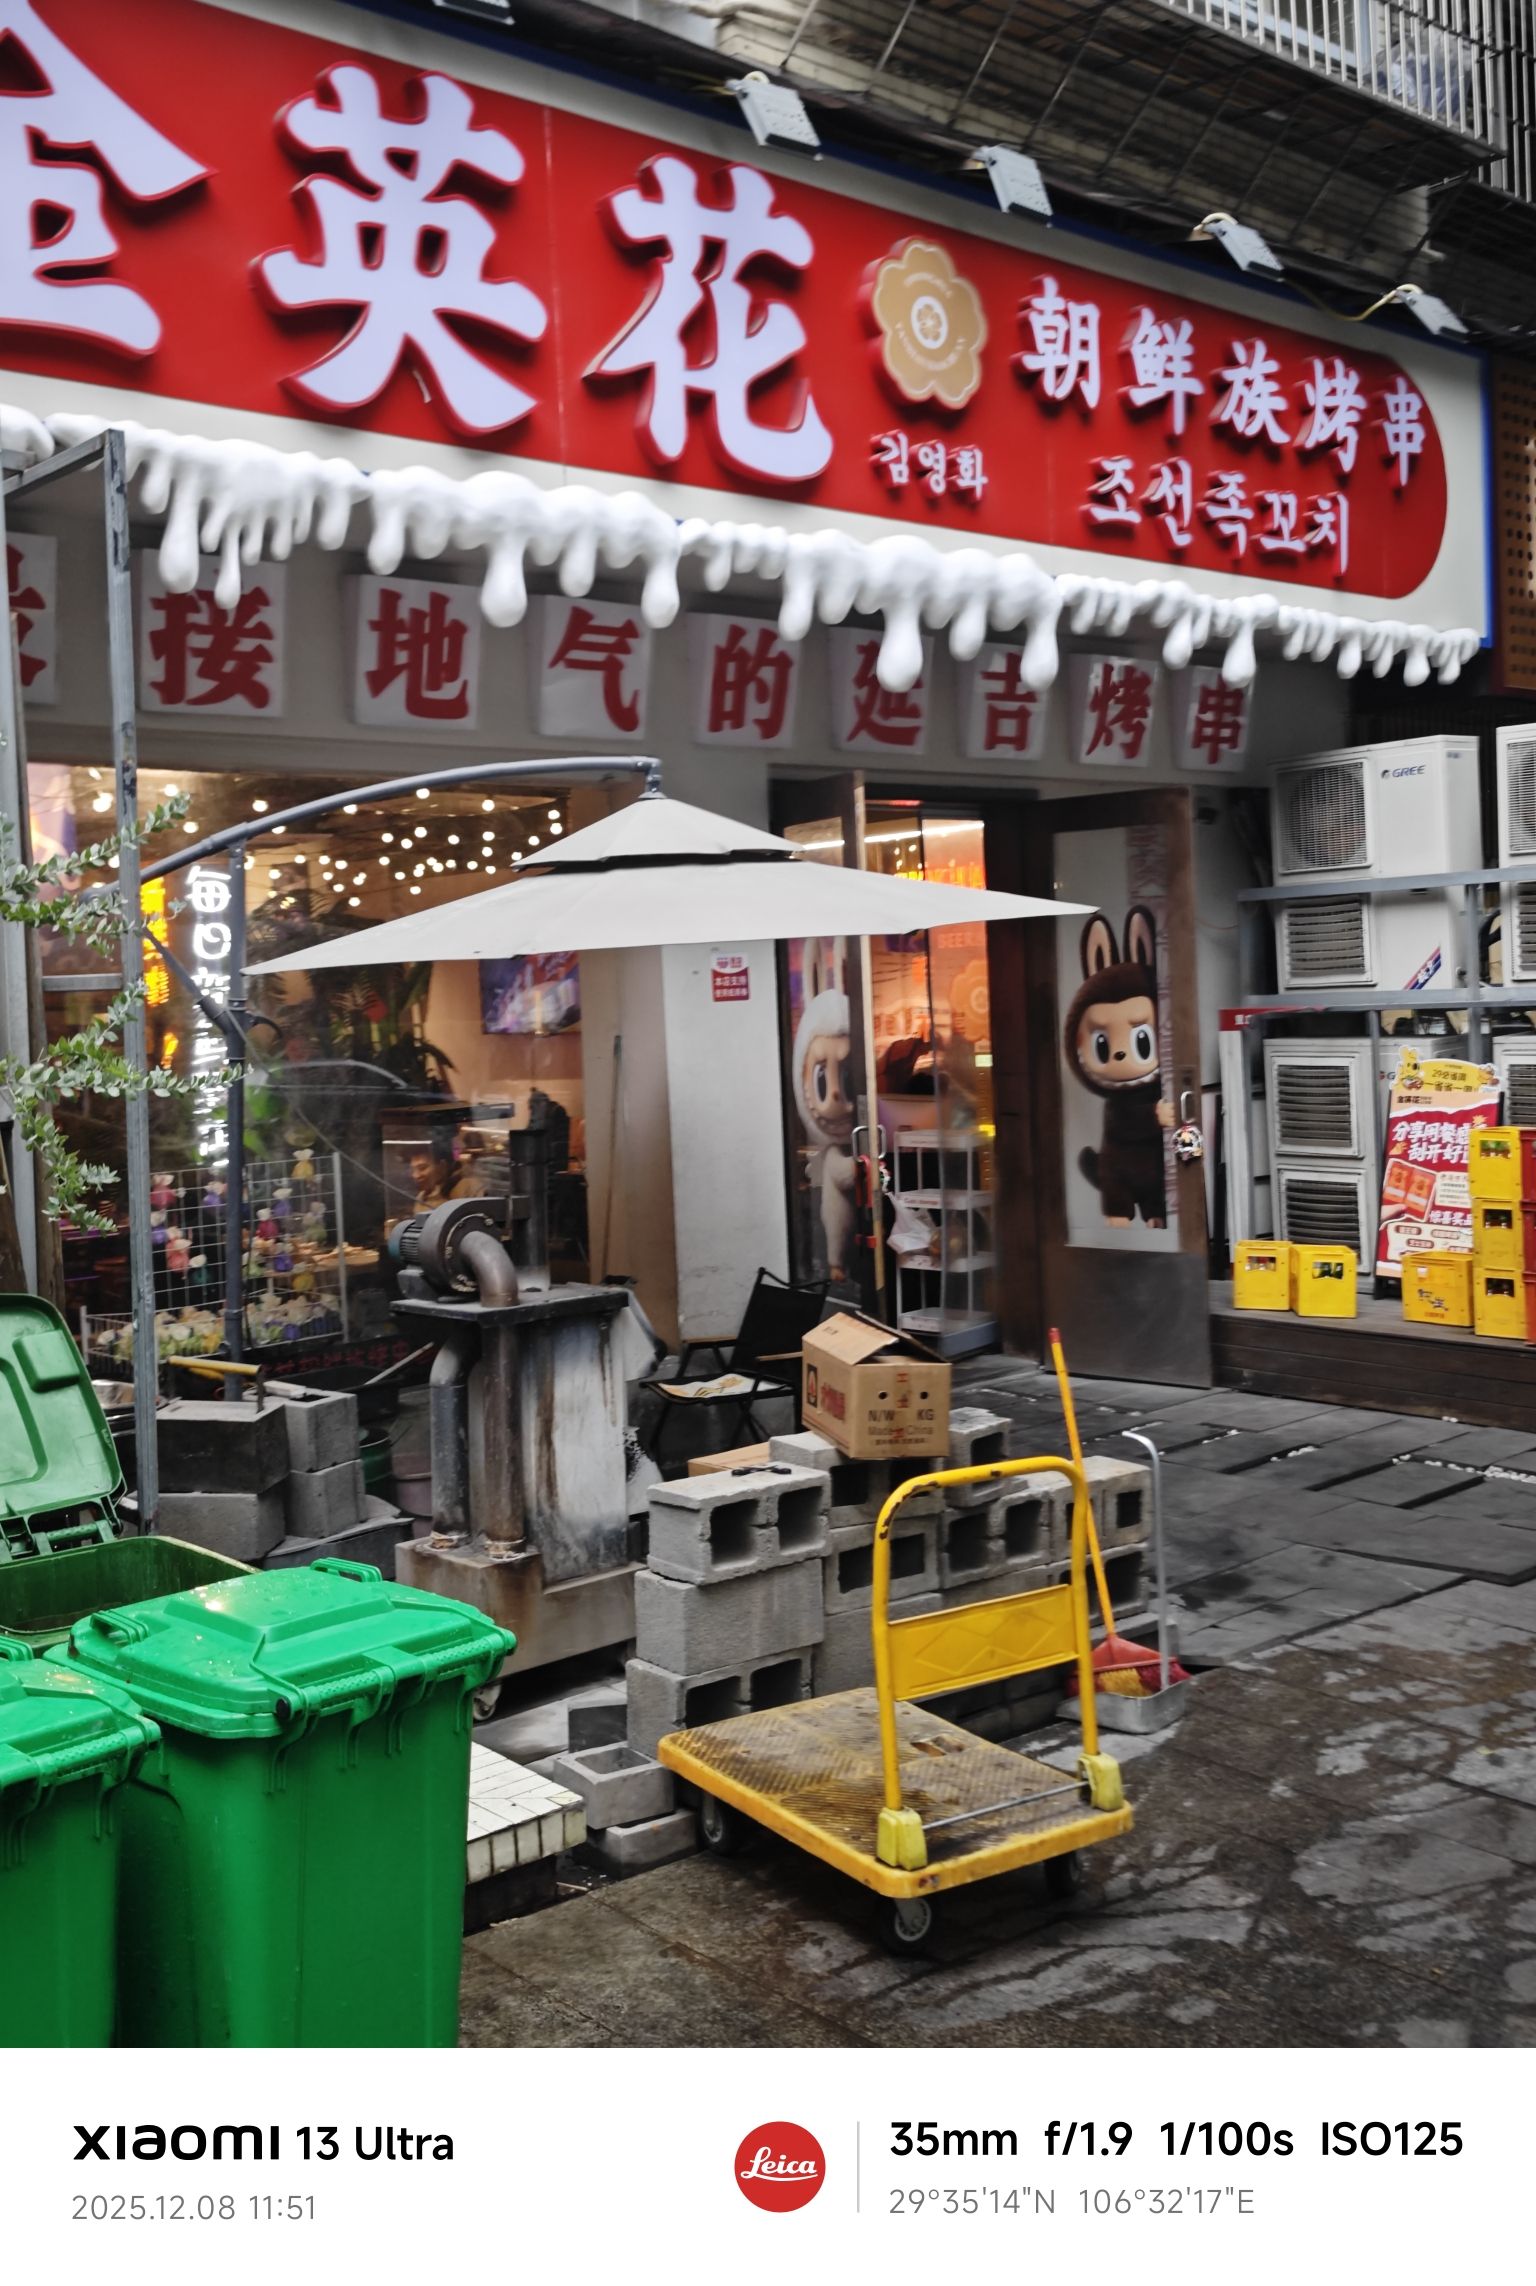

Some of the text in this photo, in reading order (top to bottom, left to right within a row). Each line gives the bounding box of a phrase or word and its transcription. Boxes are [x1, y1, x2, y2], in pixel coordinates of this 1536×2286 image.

[1018, 276, 1427, 485] 朝鲜族烤串
[874, 433, 989, 498] 김영화
[1392, 765, 1426, 778] GREE
[917, 1409, 934, 1420] KG
